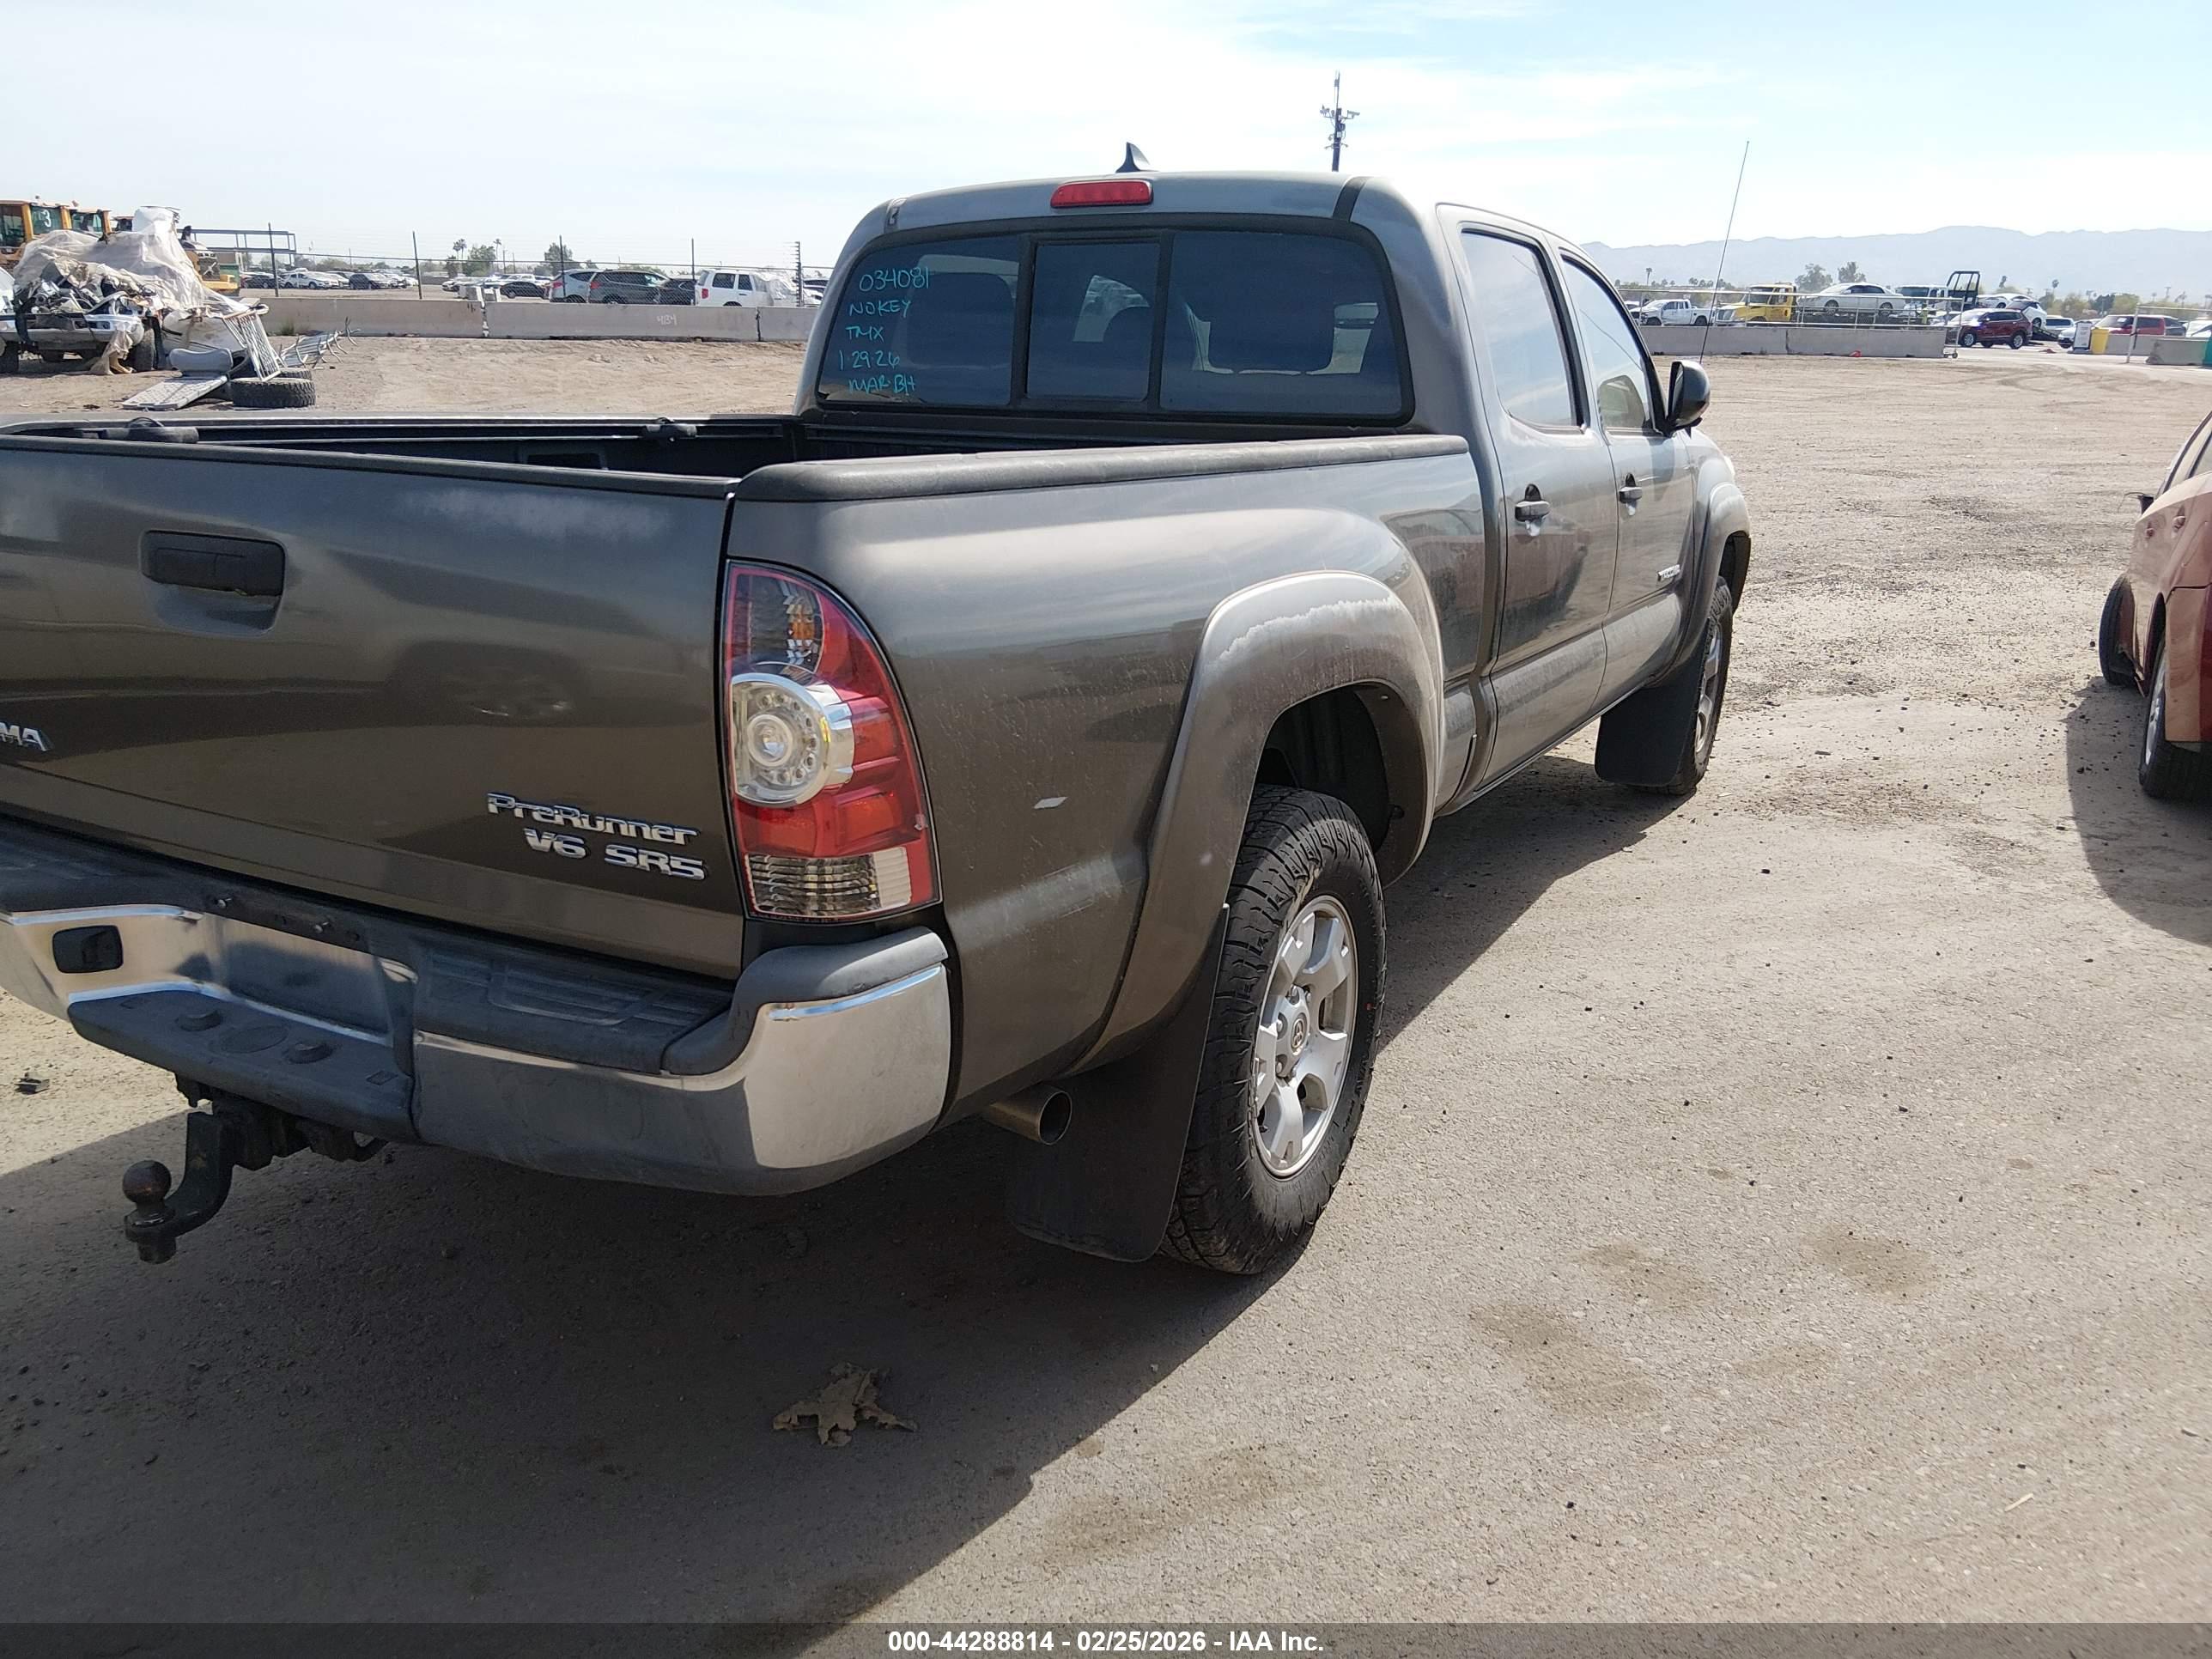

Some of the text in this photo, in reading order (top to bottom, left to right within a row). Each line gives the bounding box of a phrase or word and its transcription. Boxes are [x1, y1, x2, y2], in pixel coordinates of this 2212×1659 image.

[859, 266, 929, 292] 034081
[486, 791, 702, 846] PreRunner
[522, 827, 708, 881] V6 SR5
